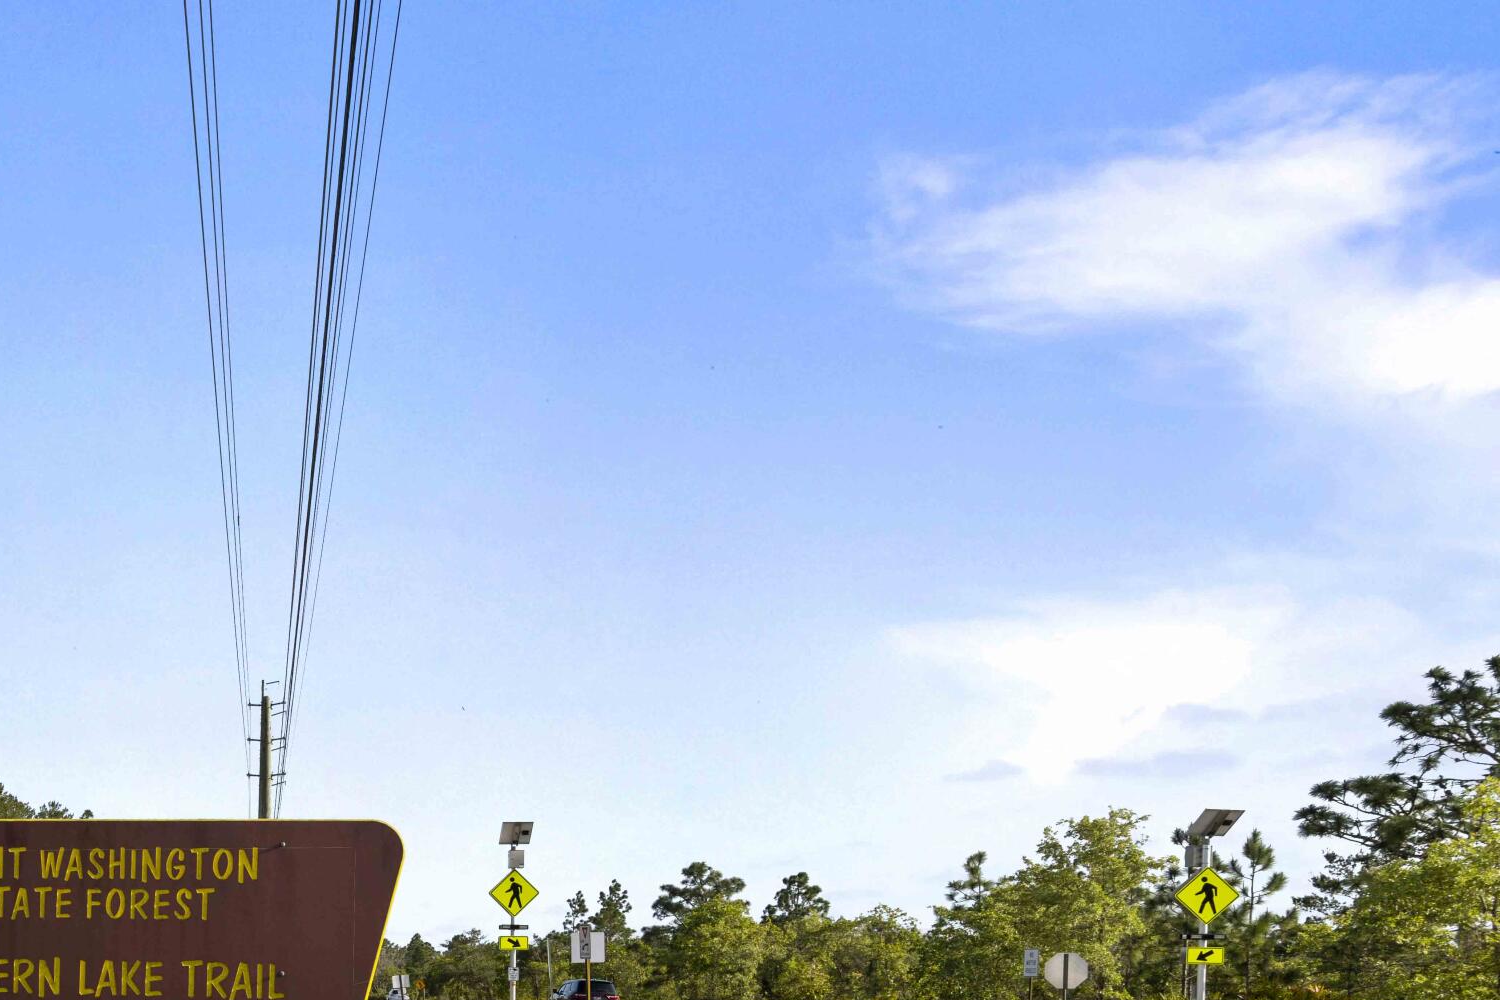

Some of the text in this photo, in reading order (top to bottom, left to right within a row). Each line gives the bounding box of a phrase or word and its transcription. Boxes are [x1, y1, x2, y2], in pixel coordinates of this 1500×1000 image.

[40, 847, 258, 884] WASHINGTON
[86, 887, 216, 921] FOREST
[79, 960, 163, 998] LAKE
[182, 960, 285, 1000] TRAIL
